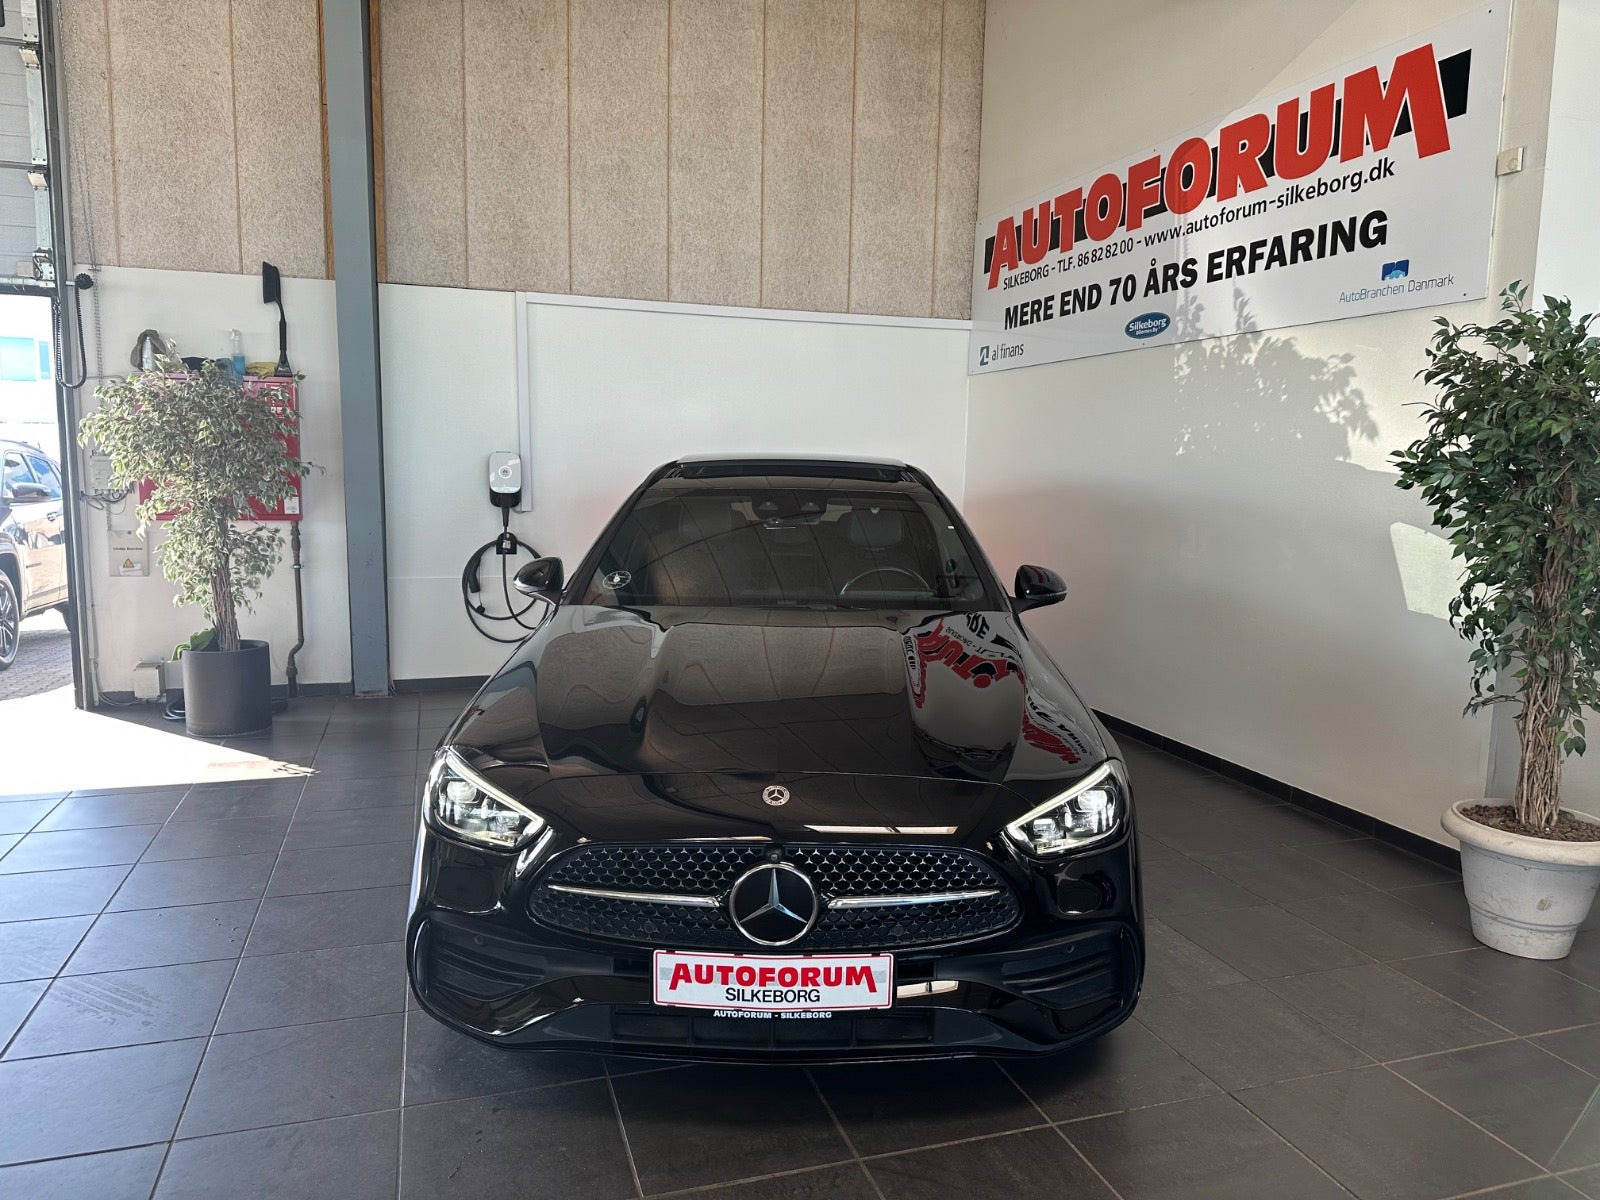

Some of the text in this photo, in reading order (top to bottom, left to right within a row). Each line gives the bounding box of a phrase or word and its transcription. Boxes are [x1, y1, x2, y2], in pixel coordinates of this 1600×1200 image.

[988, 43, 1450, 290] AUTOFORUM
[1003, 264, 1049, 291] SILKEBORG
[1057, 257, 1076, 274] TLF.
[1144, 157, 1396, 247] www.autoforum-silkeborg.dk
[1004, 210, 1388, 331] MERE END 70 ÅRS ERFARING
[1339, 274, 1454, 303] AutoBranchen Danmark
[1129, 318, 1167, 332] Silkeborg
[992, 344, 1024, 361] al finans
[669, 963, 877, 993] AUTOFORUM
[725, 987, 820, 1003] SILKEBORG
[713, 1010, 772, 1019] AUTOFORUM
[781, 1011, 832, 1019] SILKEBORG
